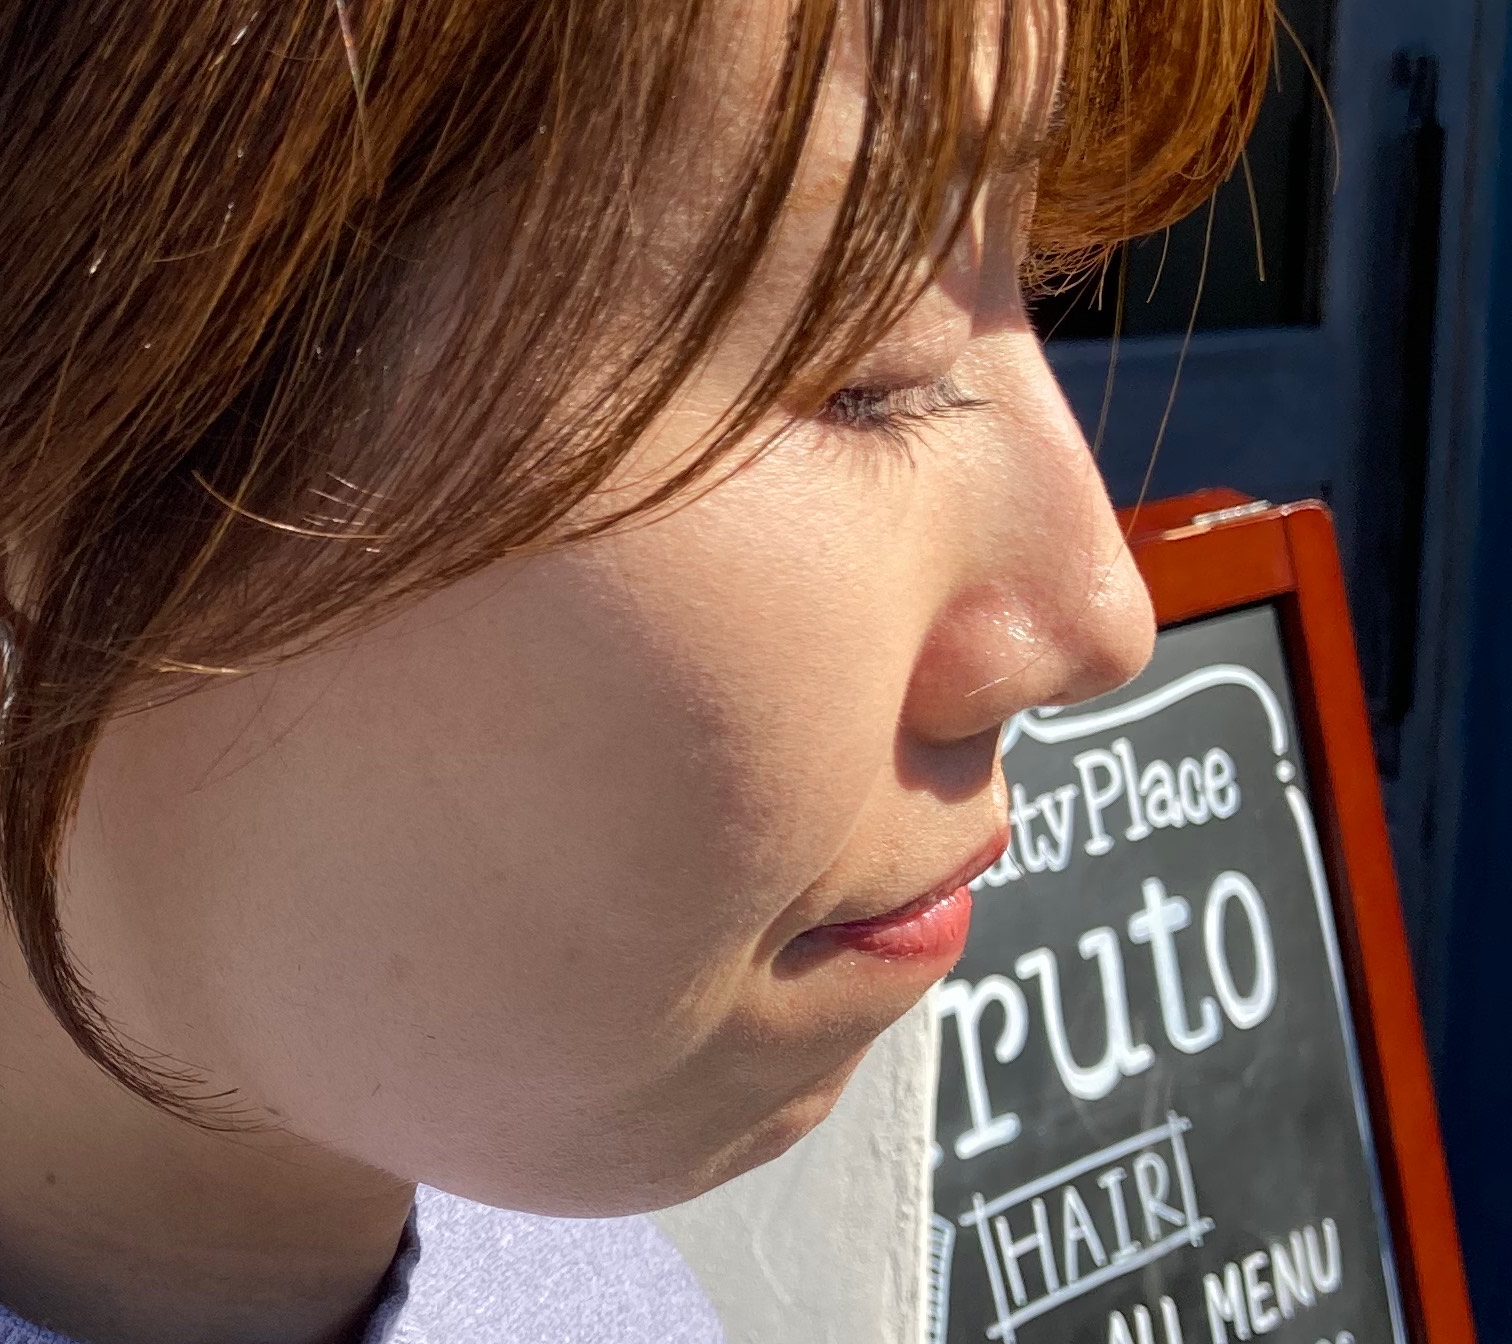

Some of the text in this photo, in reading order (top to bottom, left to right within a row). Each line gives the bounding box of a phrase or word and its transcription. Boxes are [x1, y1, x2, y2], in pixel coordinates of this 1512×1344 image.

[1072, 736, 1242, 857] Place
[930, 868, 1277, 1162] ruto
[994, 1151, 1188, 1307] HAIR
